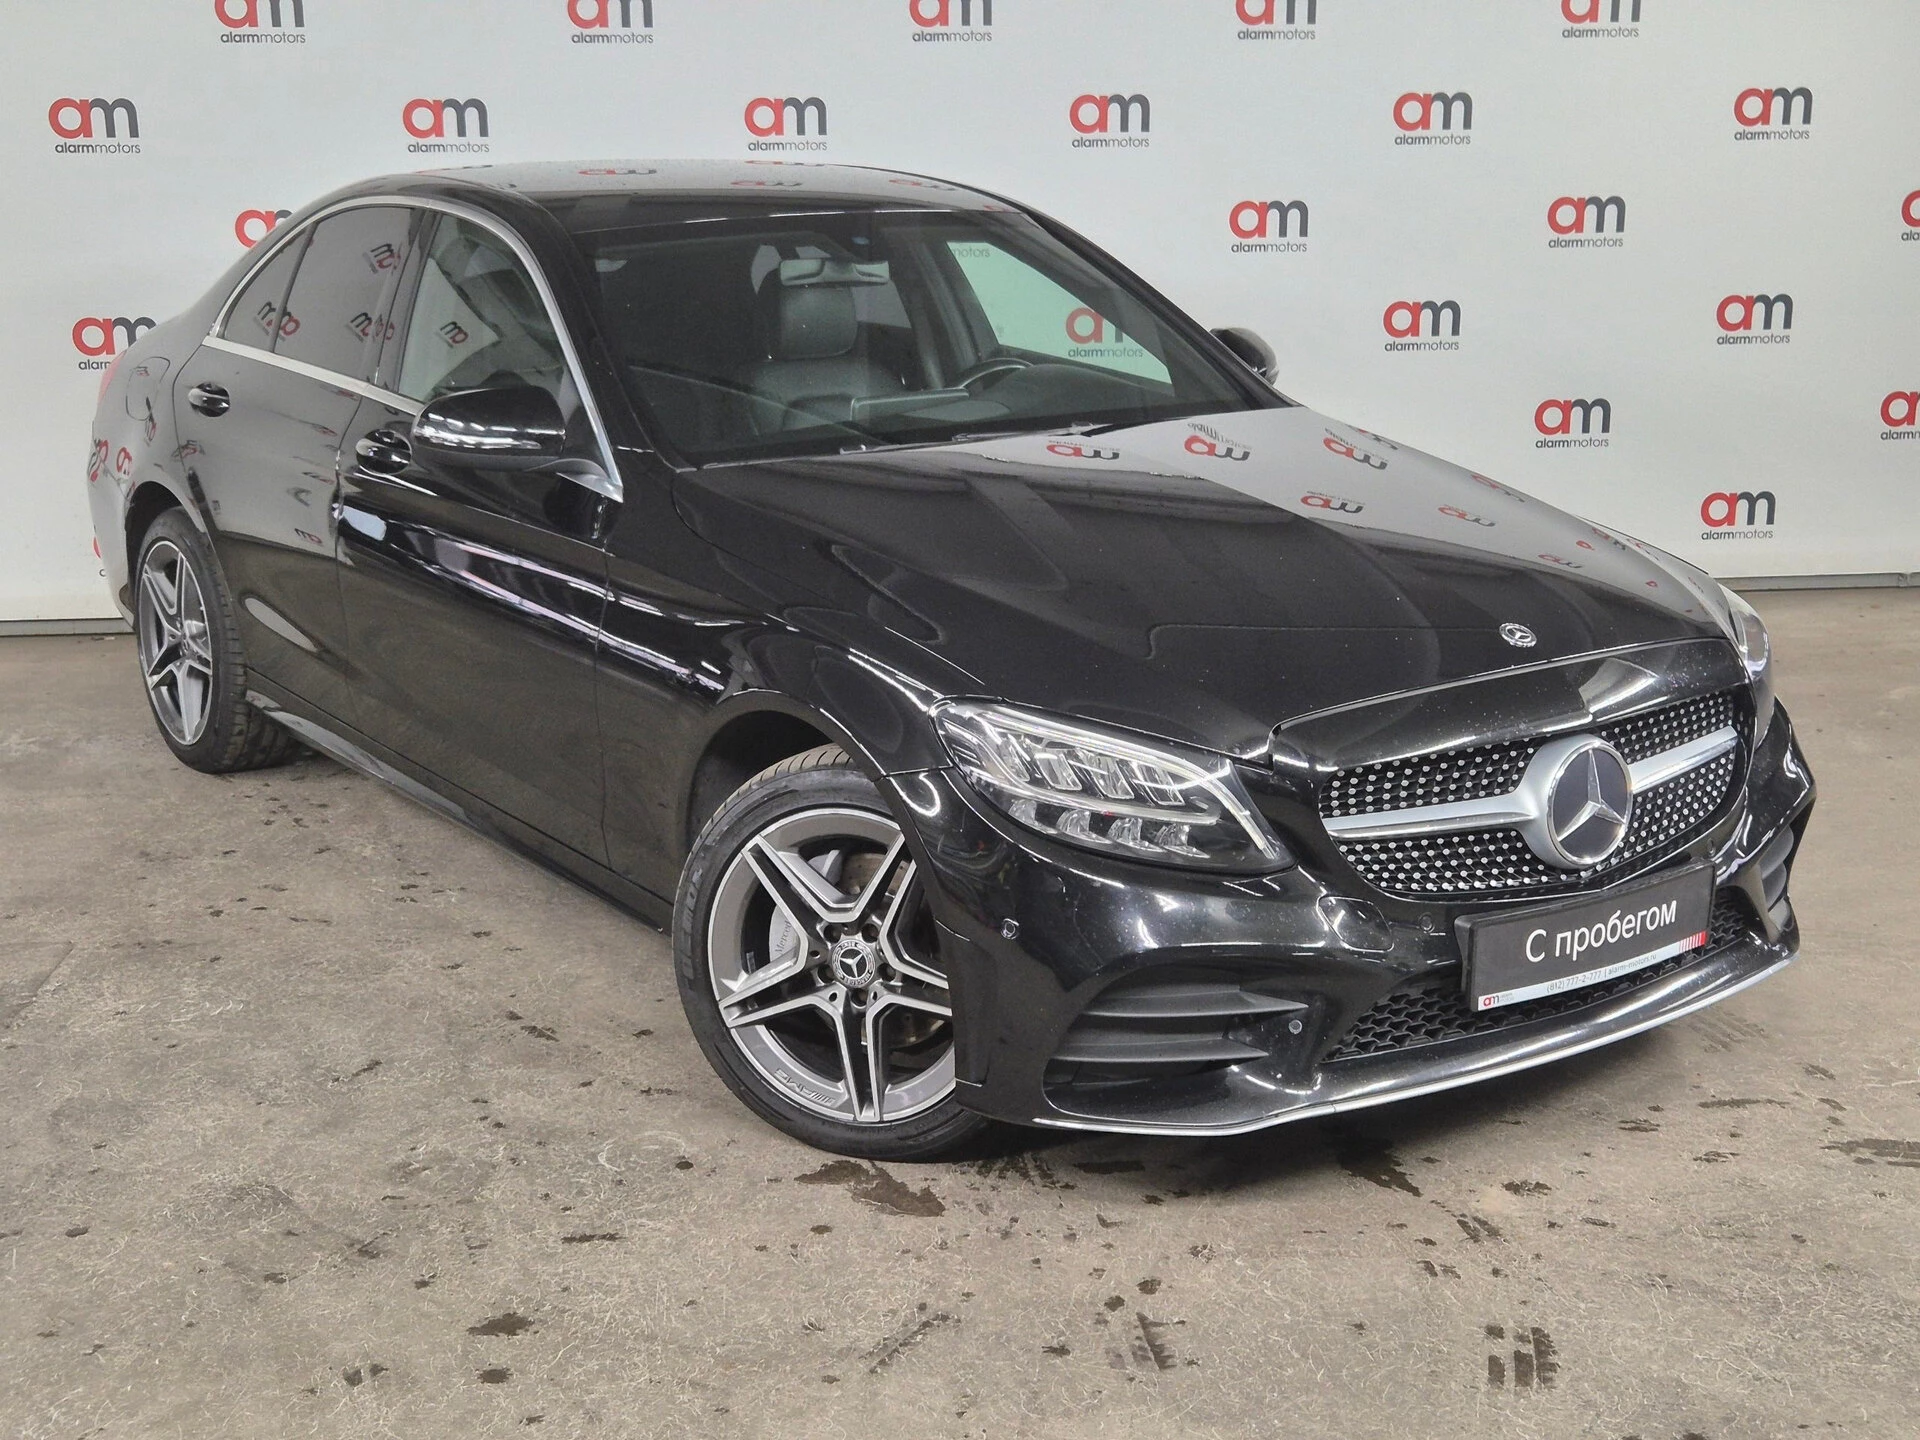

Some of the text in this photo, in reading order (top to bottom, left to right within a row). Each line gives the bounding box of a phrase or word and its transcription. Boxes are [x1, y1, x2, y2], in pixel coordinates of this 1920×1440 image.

[214, 0, 305, 29] am
[567, 0, 653, 29] am
[909, 0, 992, 27] am
[1235, 0, 1316, 26] am
[1560, 0, 1641, 24] am
[220, 31, 306, 43] alarmmotors
[571, 31, 654, 43] alarmmotors
[911, 30, 993, 42] alarmmotors
[1237, 28, 1316, 40] alarmmotors
[1561, 26, 1640, 38] alarmmotors
[48, 97, 139, 140] am
[402, 98, 488, 140] am
[744, 97, 827, 138] am
[1069, 94, 1150, 134] am
[1392, 92, 1472, 131] am
[1734, 87, 1813, 127] am
[55, 141, 141, 153] alarmmotors
[407, 141, 490, 153] alarmmotors
[747, 140, 828, 151] alarmmotors
[1071, 136, 1150, 148] alarmmotors
[1394, 133, 1471, 145] alarmmotors
[1734, 129, 1811, 141] alarmmotors
[1228, 200, 1308, 240] am
[1547, 196, 1626, 235] am
[235, 209, 293, 249] a
[1230, 242, 1308, 253] alarmmotors
[1548, 237, 1625, 248] alarmmotors
[1382, 300, 1461, 338] am
[1716, 293, 1794, 332] am
[1066, 307, 1124, 345] a
[1384, 339, 1461, 351] alarmmotors
[1716, 334, 1791, 345] alarmmotors
[1068, 347, 1143, 358] alarmmotors
[1534, 398, 1611, 435] am
[1880, 391, 1920, 427] a
[1534, 437, 1610, 449] alarmmotors
[1700, 491, 1776, 528] am
[1701, 530, 1774, 540] alarmmotors
[1525, 900, 1677, 963] С пробегом
[1483, 994, 1500, 1007] am
